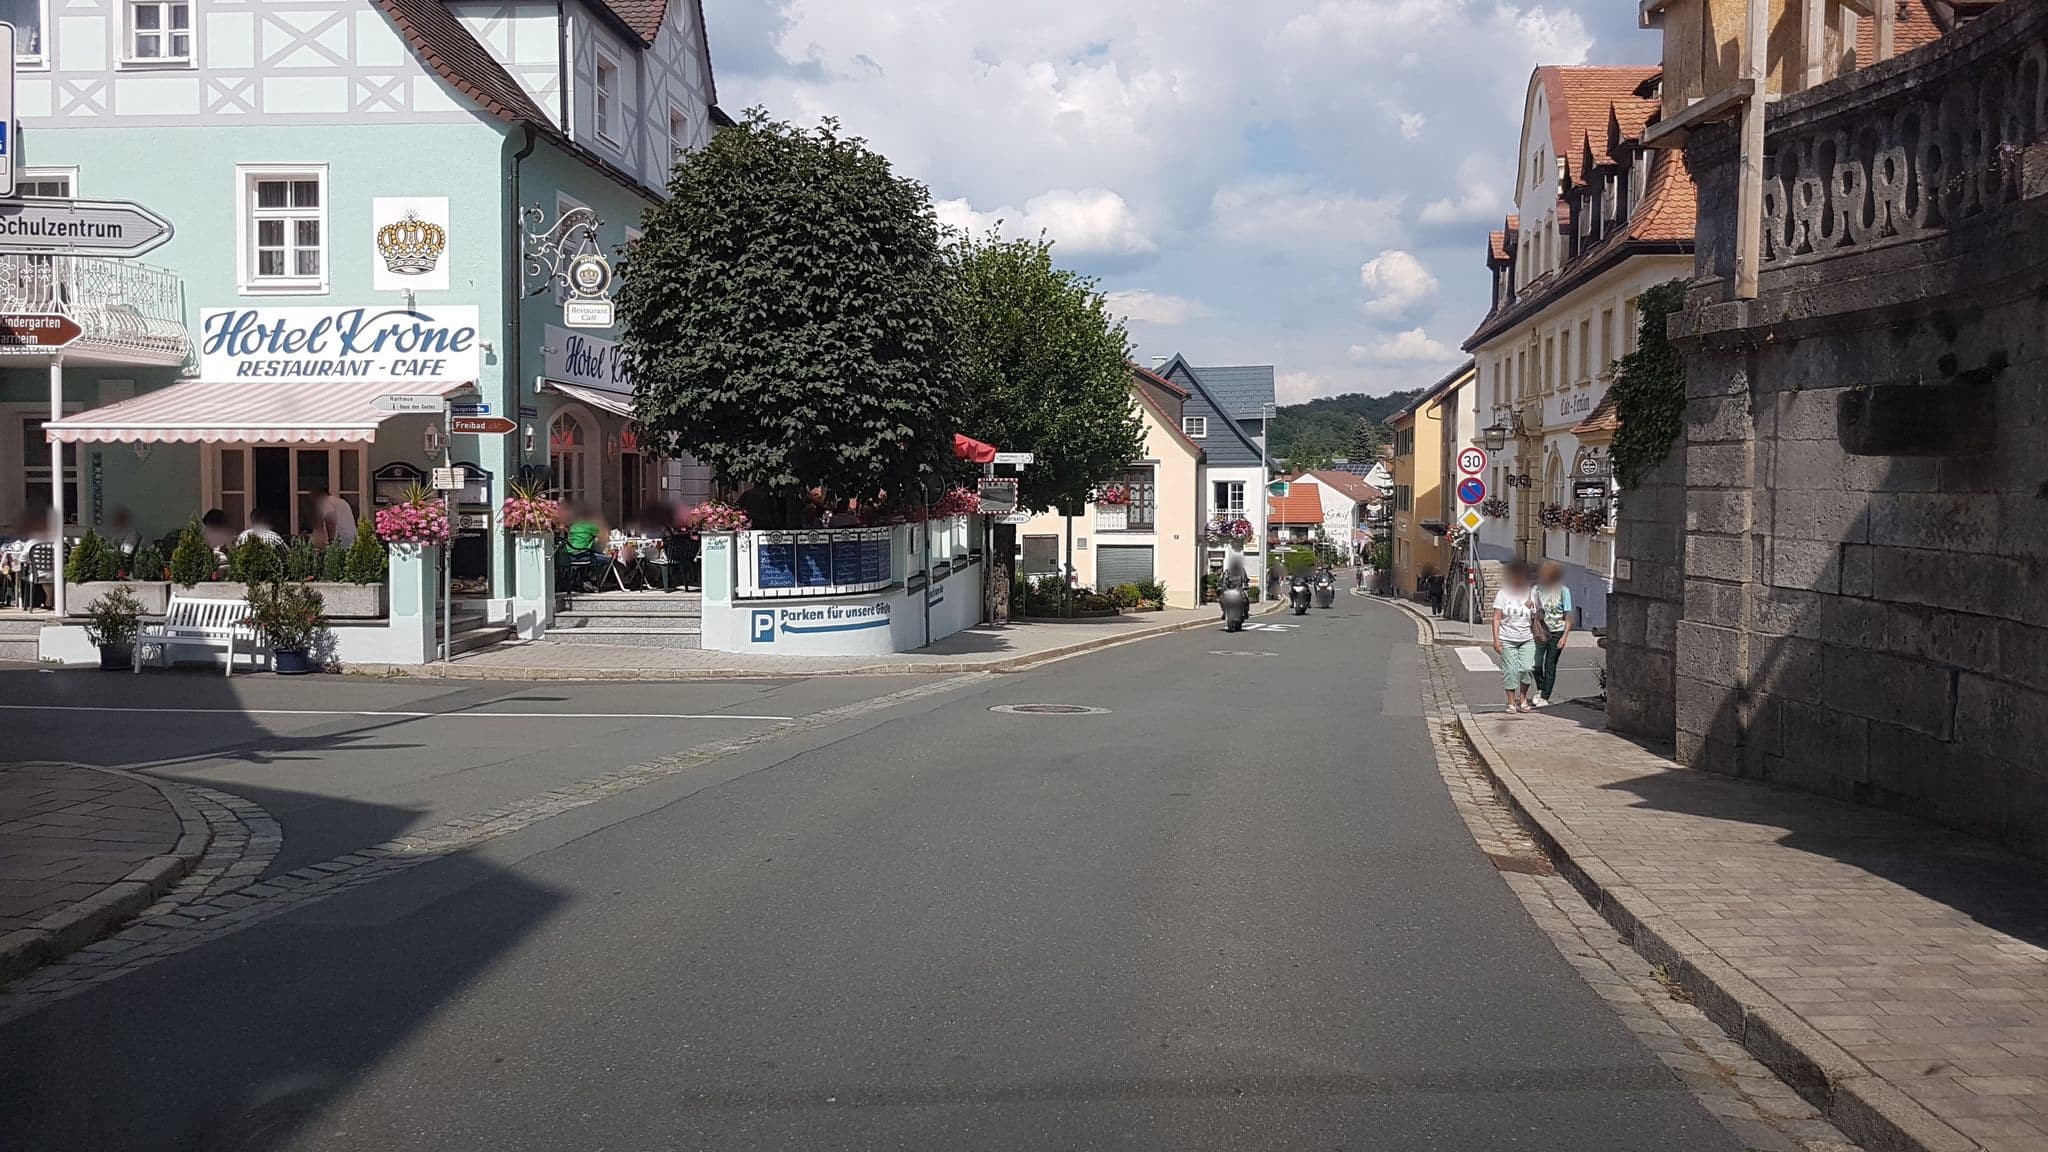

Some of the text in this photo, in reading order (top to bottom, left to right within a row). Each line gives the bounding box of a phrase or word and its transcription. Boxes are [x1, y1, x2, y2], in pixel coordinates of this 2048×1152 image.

[0, 216, 122, 238] Schulzentrum
[571, 306, 608, 314] Restaurant
[203, 308, 475, 357] Hotel Krone
[566, 335, 605, 379] Hotel
[236, 359, 375, 377] RESTAURANT
[390, 359, 447, 377] CAFE
[455, 421, 486, 430] Freibad
[1463, 455, 1481, 468] 30
[780, 608, 824, 621] Parken
[827, 606, 843, 619] für
[846, 605, 875, 618] unsere
[755, 614, 773, 638] P
